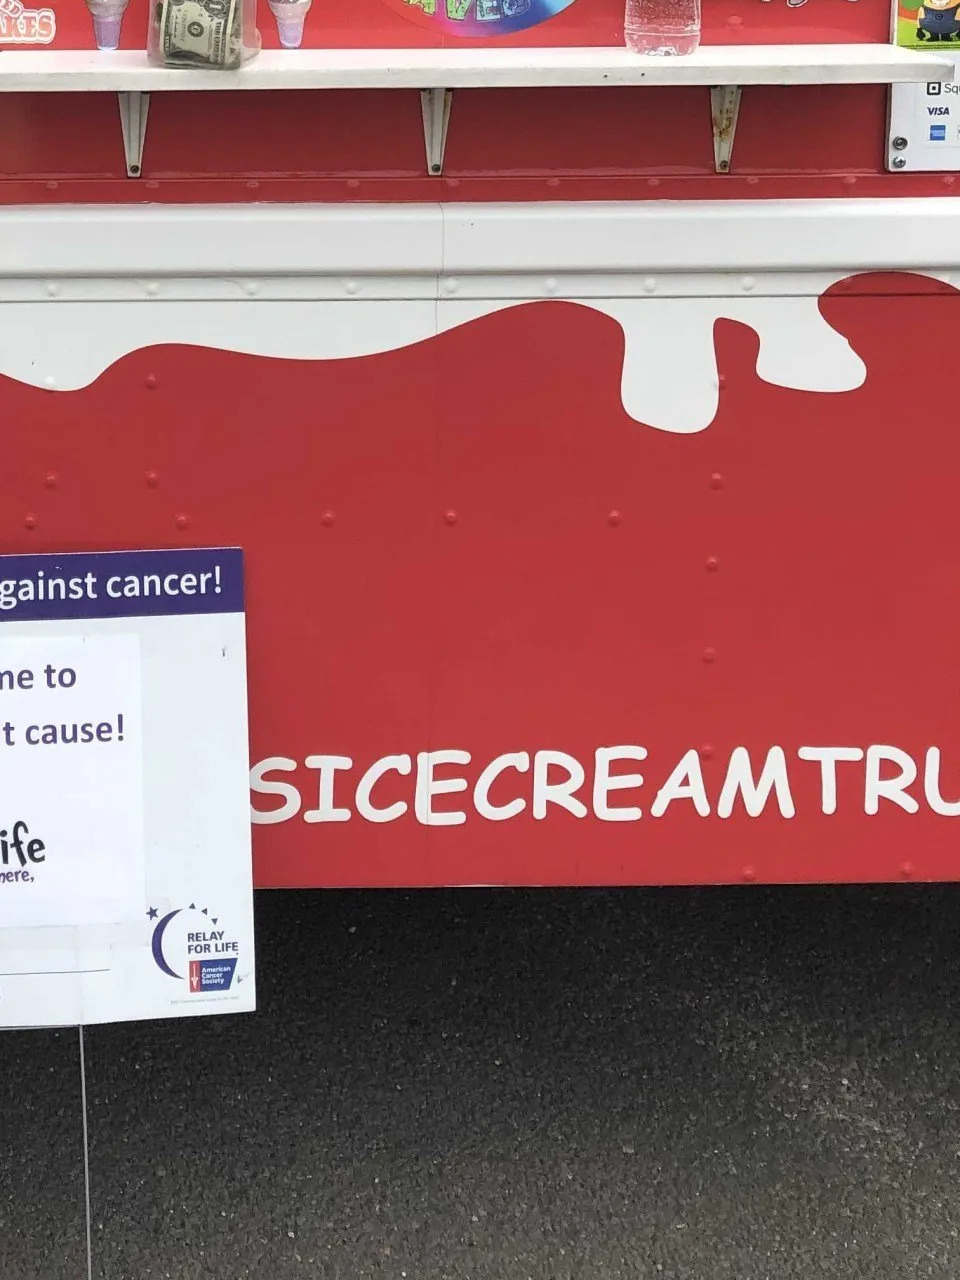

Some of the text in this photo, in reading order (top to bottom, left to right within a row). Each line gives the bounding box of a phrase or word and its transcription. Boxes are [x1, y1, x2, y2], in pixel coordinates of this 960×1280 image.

[927, 107, 949, 115] VISA
[106, 566, 222, 598] cancer!
[44, 664, 77, 689] to
[24, 714, 126, 745] cause!
[187, 931, 225, 942] RELAY
[187, 942, 238, 954] FOR LIFE
